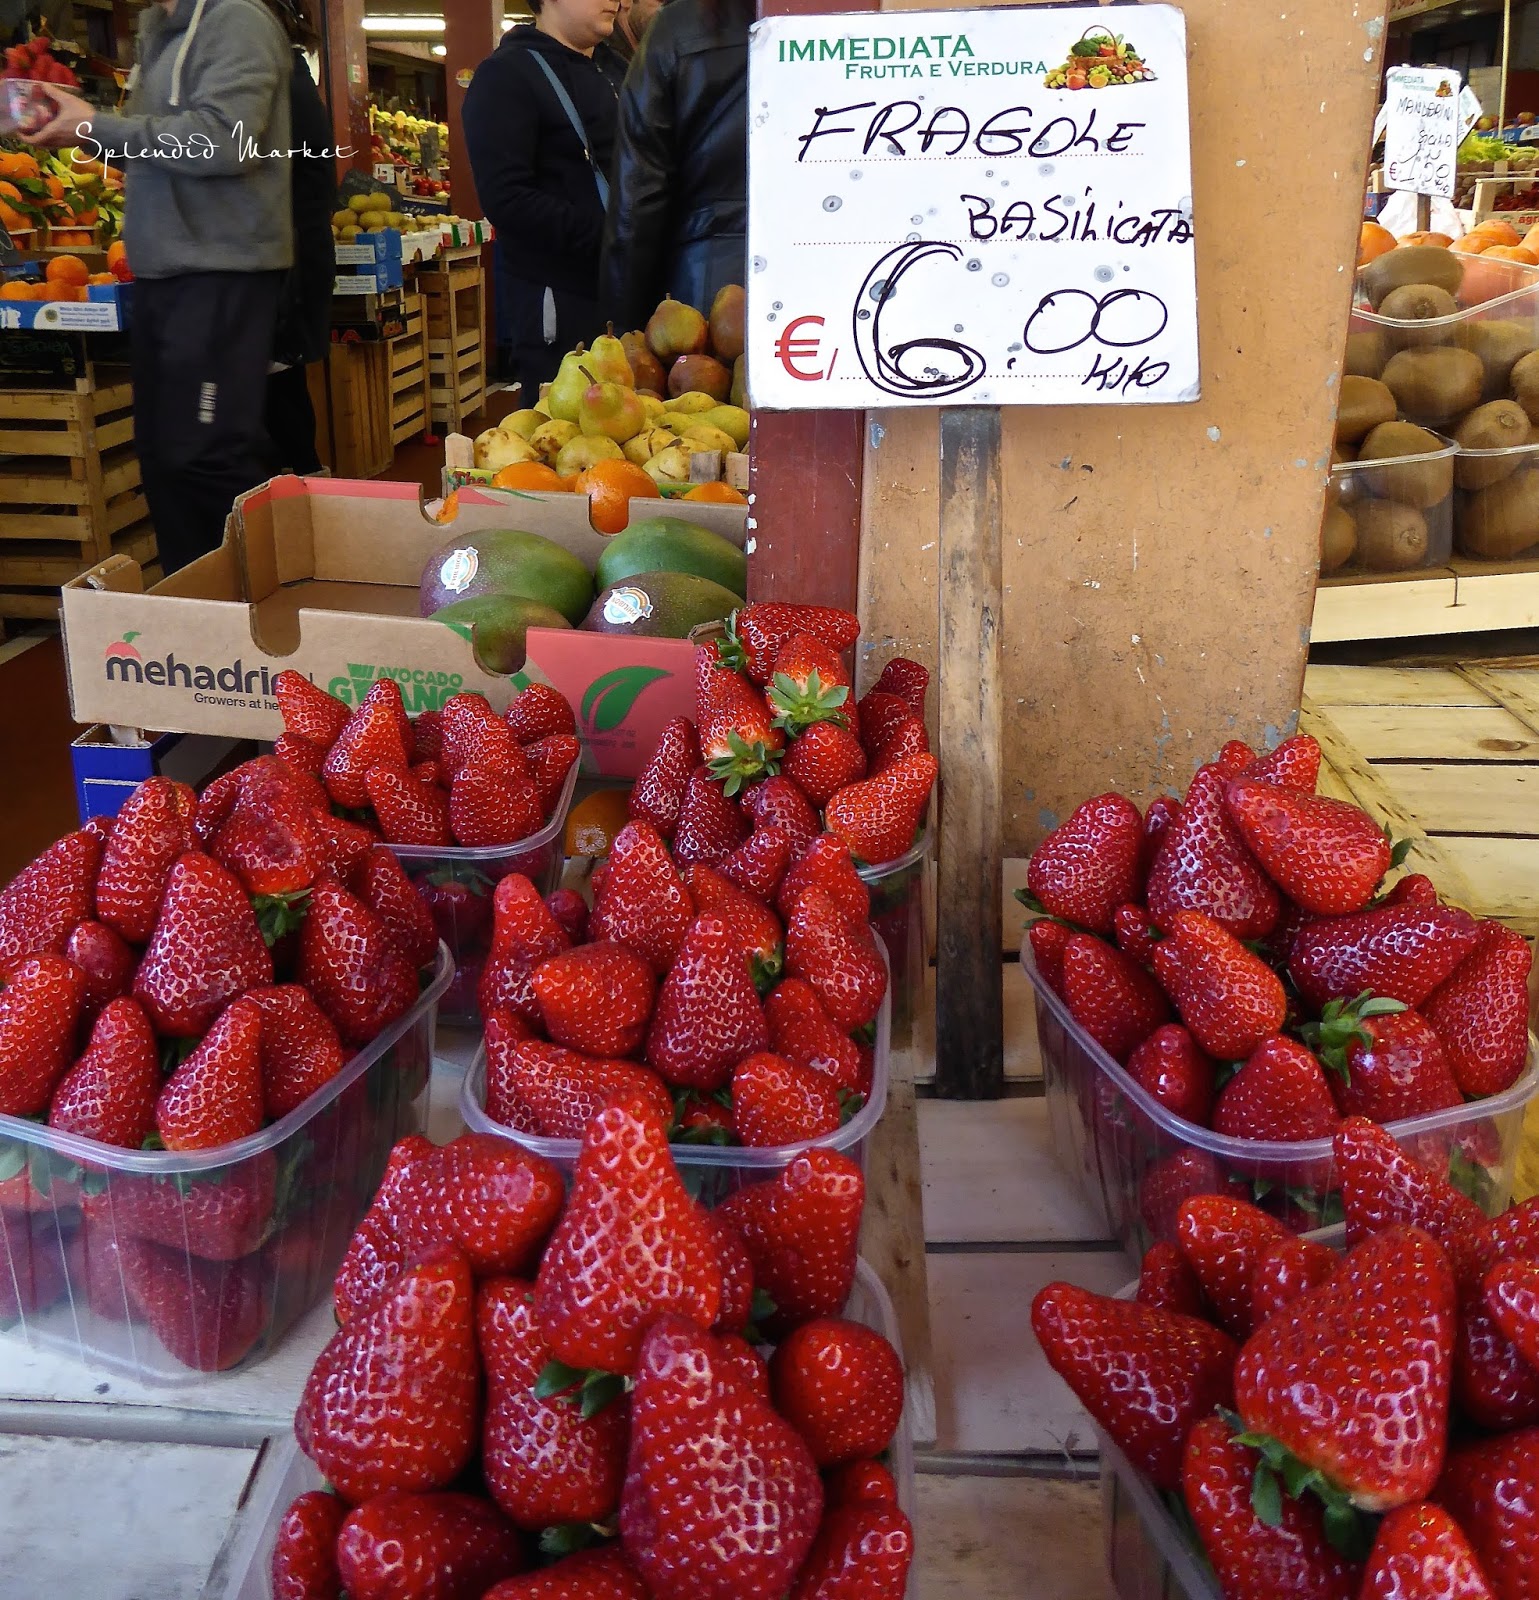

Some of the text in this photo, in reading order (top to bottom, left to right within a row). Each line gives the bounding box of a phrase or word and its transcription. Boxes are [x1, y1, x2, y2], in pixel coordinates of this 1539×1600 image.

[778, 34, 976, 63] IMMEDIATA
[845, 63, 924, 80] FRUTTA
[947, 60, 1049, 77] VERDURA
[798, 100, 1147, 162] FRAGOLE
[106, 652, 279, 696] mehadri
[376, 665, 464, 688] AVOCADO
[193, 692, 281, 711] Growers at he
